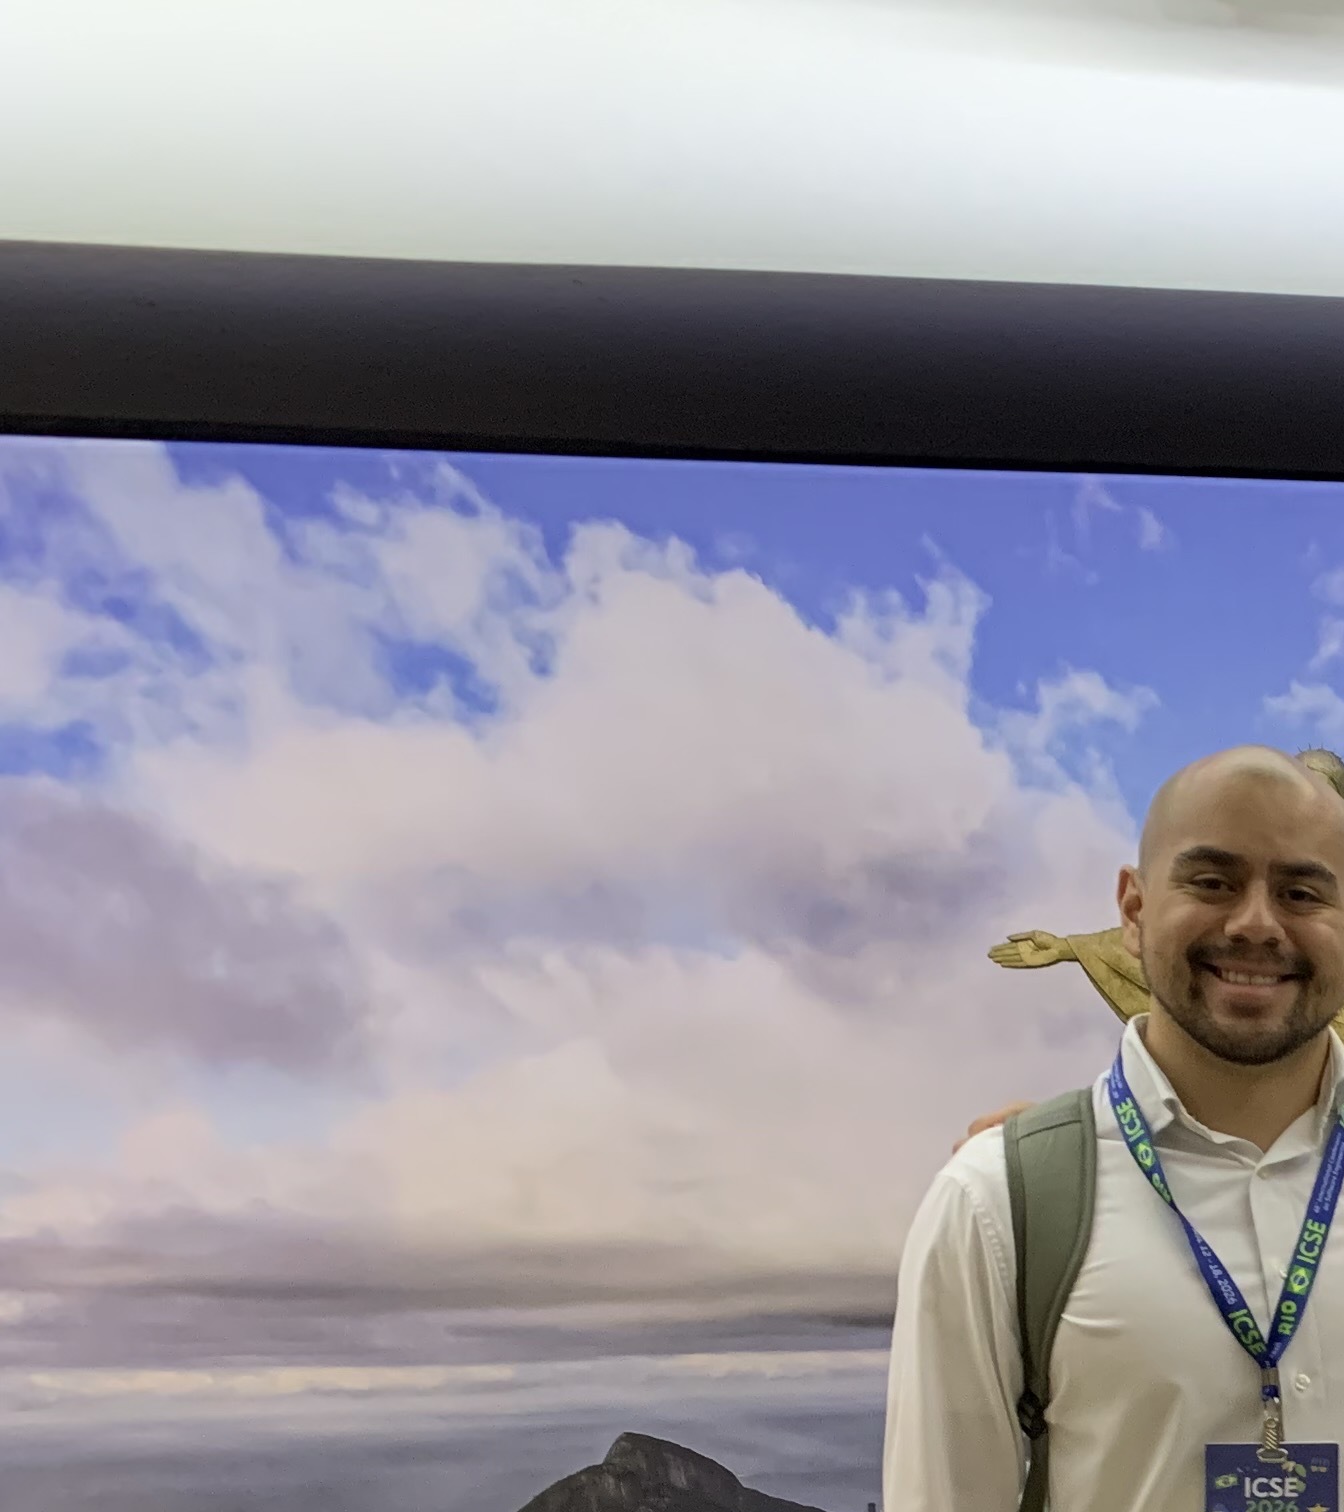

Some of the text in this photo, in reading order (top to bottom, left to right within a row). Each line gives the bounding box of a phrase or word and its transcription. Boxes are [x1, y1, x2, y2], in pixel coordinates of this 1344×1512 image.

[1116, 1097, 1145, 1142] ICSE
[1296, 1218, 1327, 1264] ICSE
[1228, 1309, 1267, 1355] ICSE
[1277, 1299, 1298, 1336] RIO
[1244, 1477, 1299, 1498] ICSE
